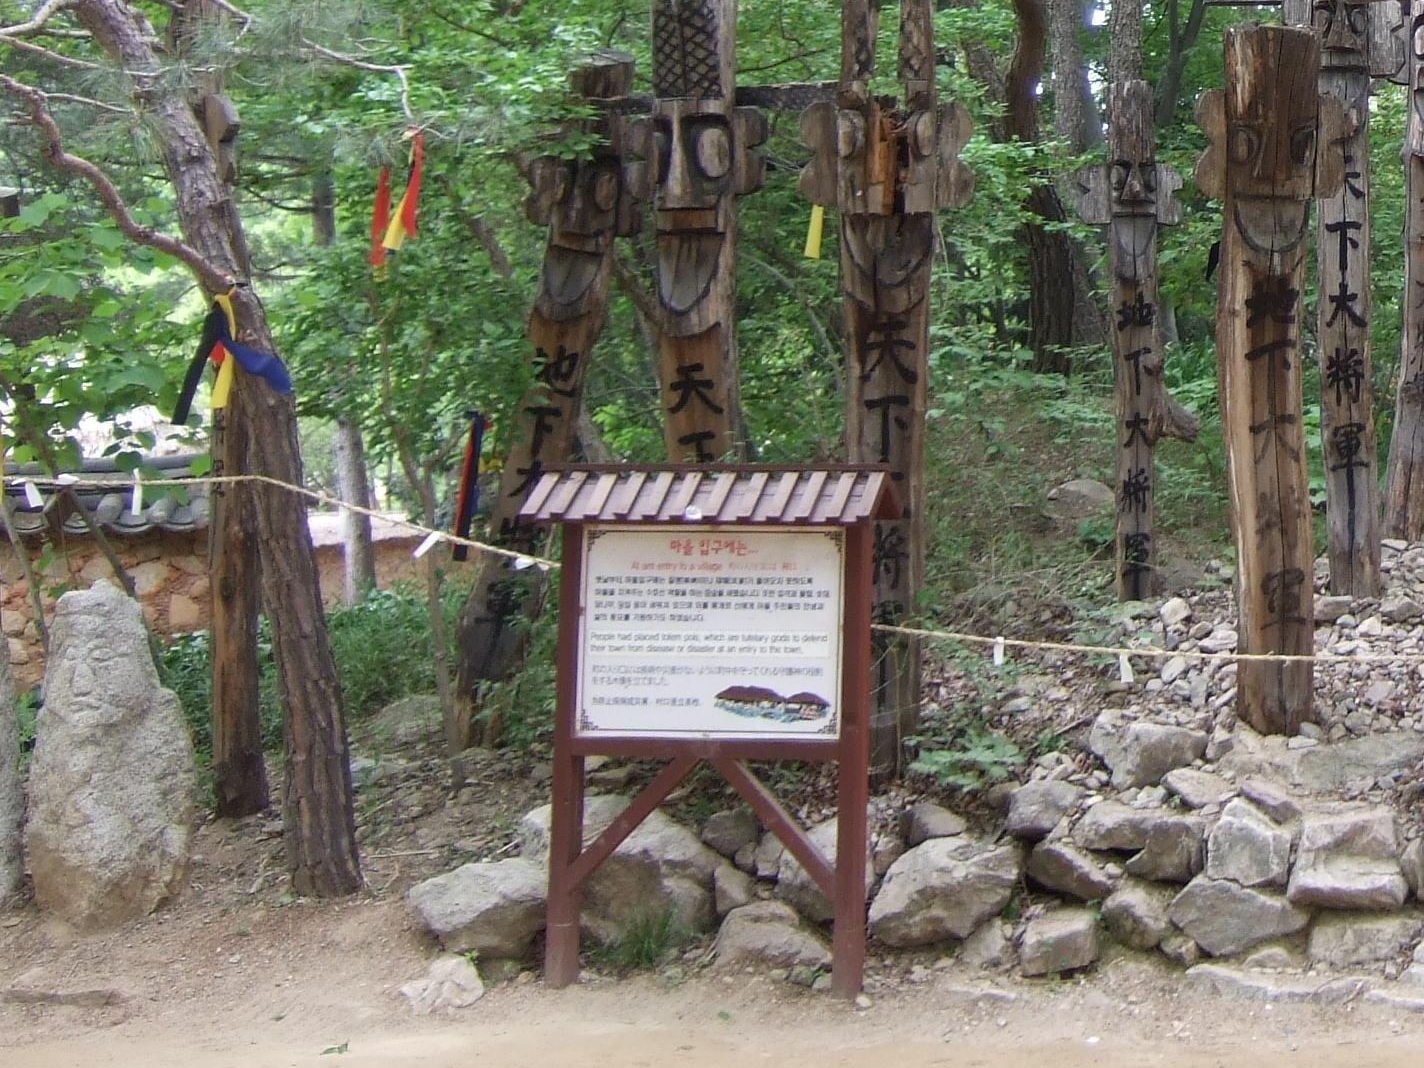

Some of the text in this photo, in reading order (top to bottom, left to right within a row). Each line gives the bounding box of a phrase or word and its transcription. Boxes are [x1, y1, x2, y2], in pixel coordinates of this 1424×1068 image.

[1245, 286, 1312, 632] 地下大軍
[669, 539, 693, 557] 마을
[590, 632, 615, 642] People
[617, 633, 632, 641] had
[704, 633, 725, 641] which
